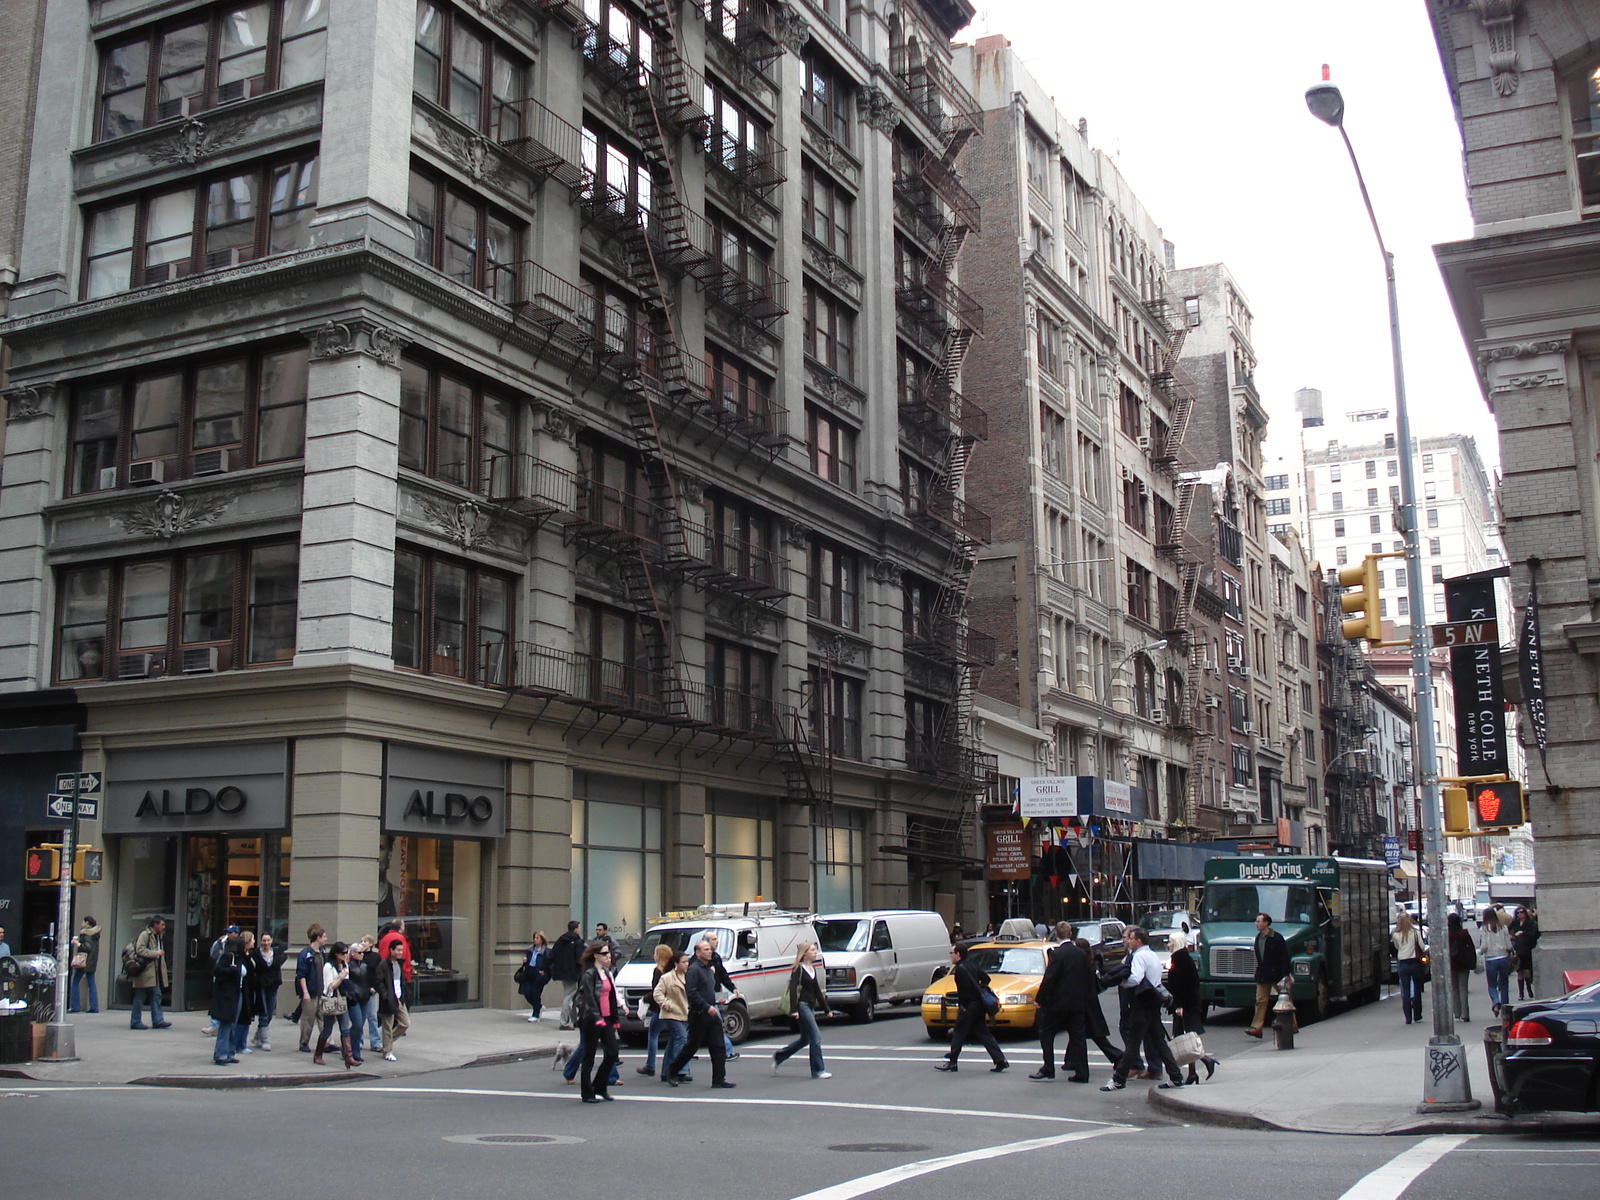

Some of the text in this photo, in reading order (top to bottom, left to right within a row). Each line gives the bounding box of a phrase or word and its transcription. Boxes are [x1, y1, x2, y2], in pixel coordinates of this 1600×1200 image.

[1446, 624, 1483, 645] 5 AV
[1471, 608, 1497, 761] KNETH COLE
[1468, 712, 1479, 762] new york
[62, 779, 95, 789] ONE WAY
[1035, 785, 1061, 794] GRILL
[56, 802, 71, 811] ONE
[135, 786, 247, 817] ALDO
[403, 790, 493, 822] ALDO
[996, 834, 1021, 843] GRILL
[400, 870, 406, 889] NO
[1239, 862, 1303, 880] Poland Spring
